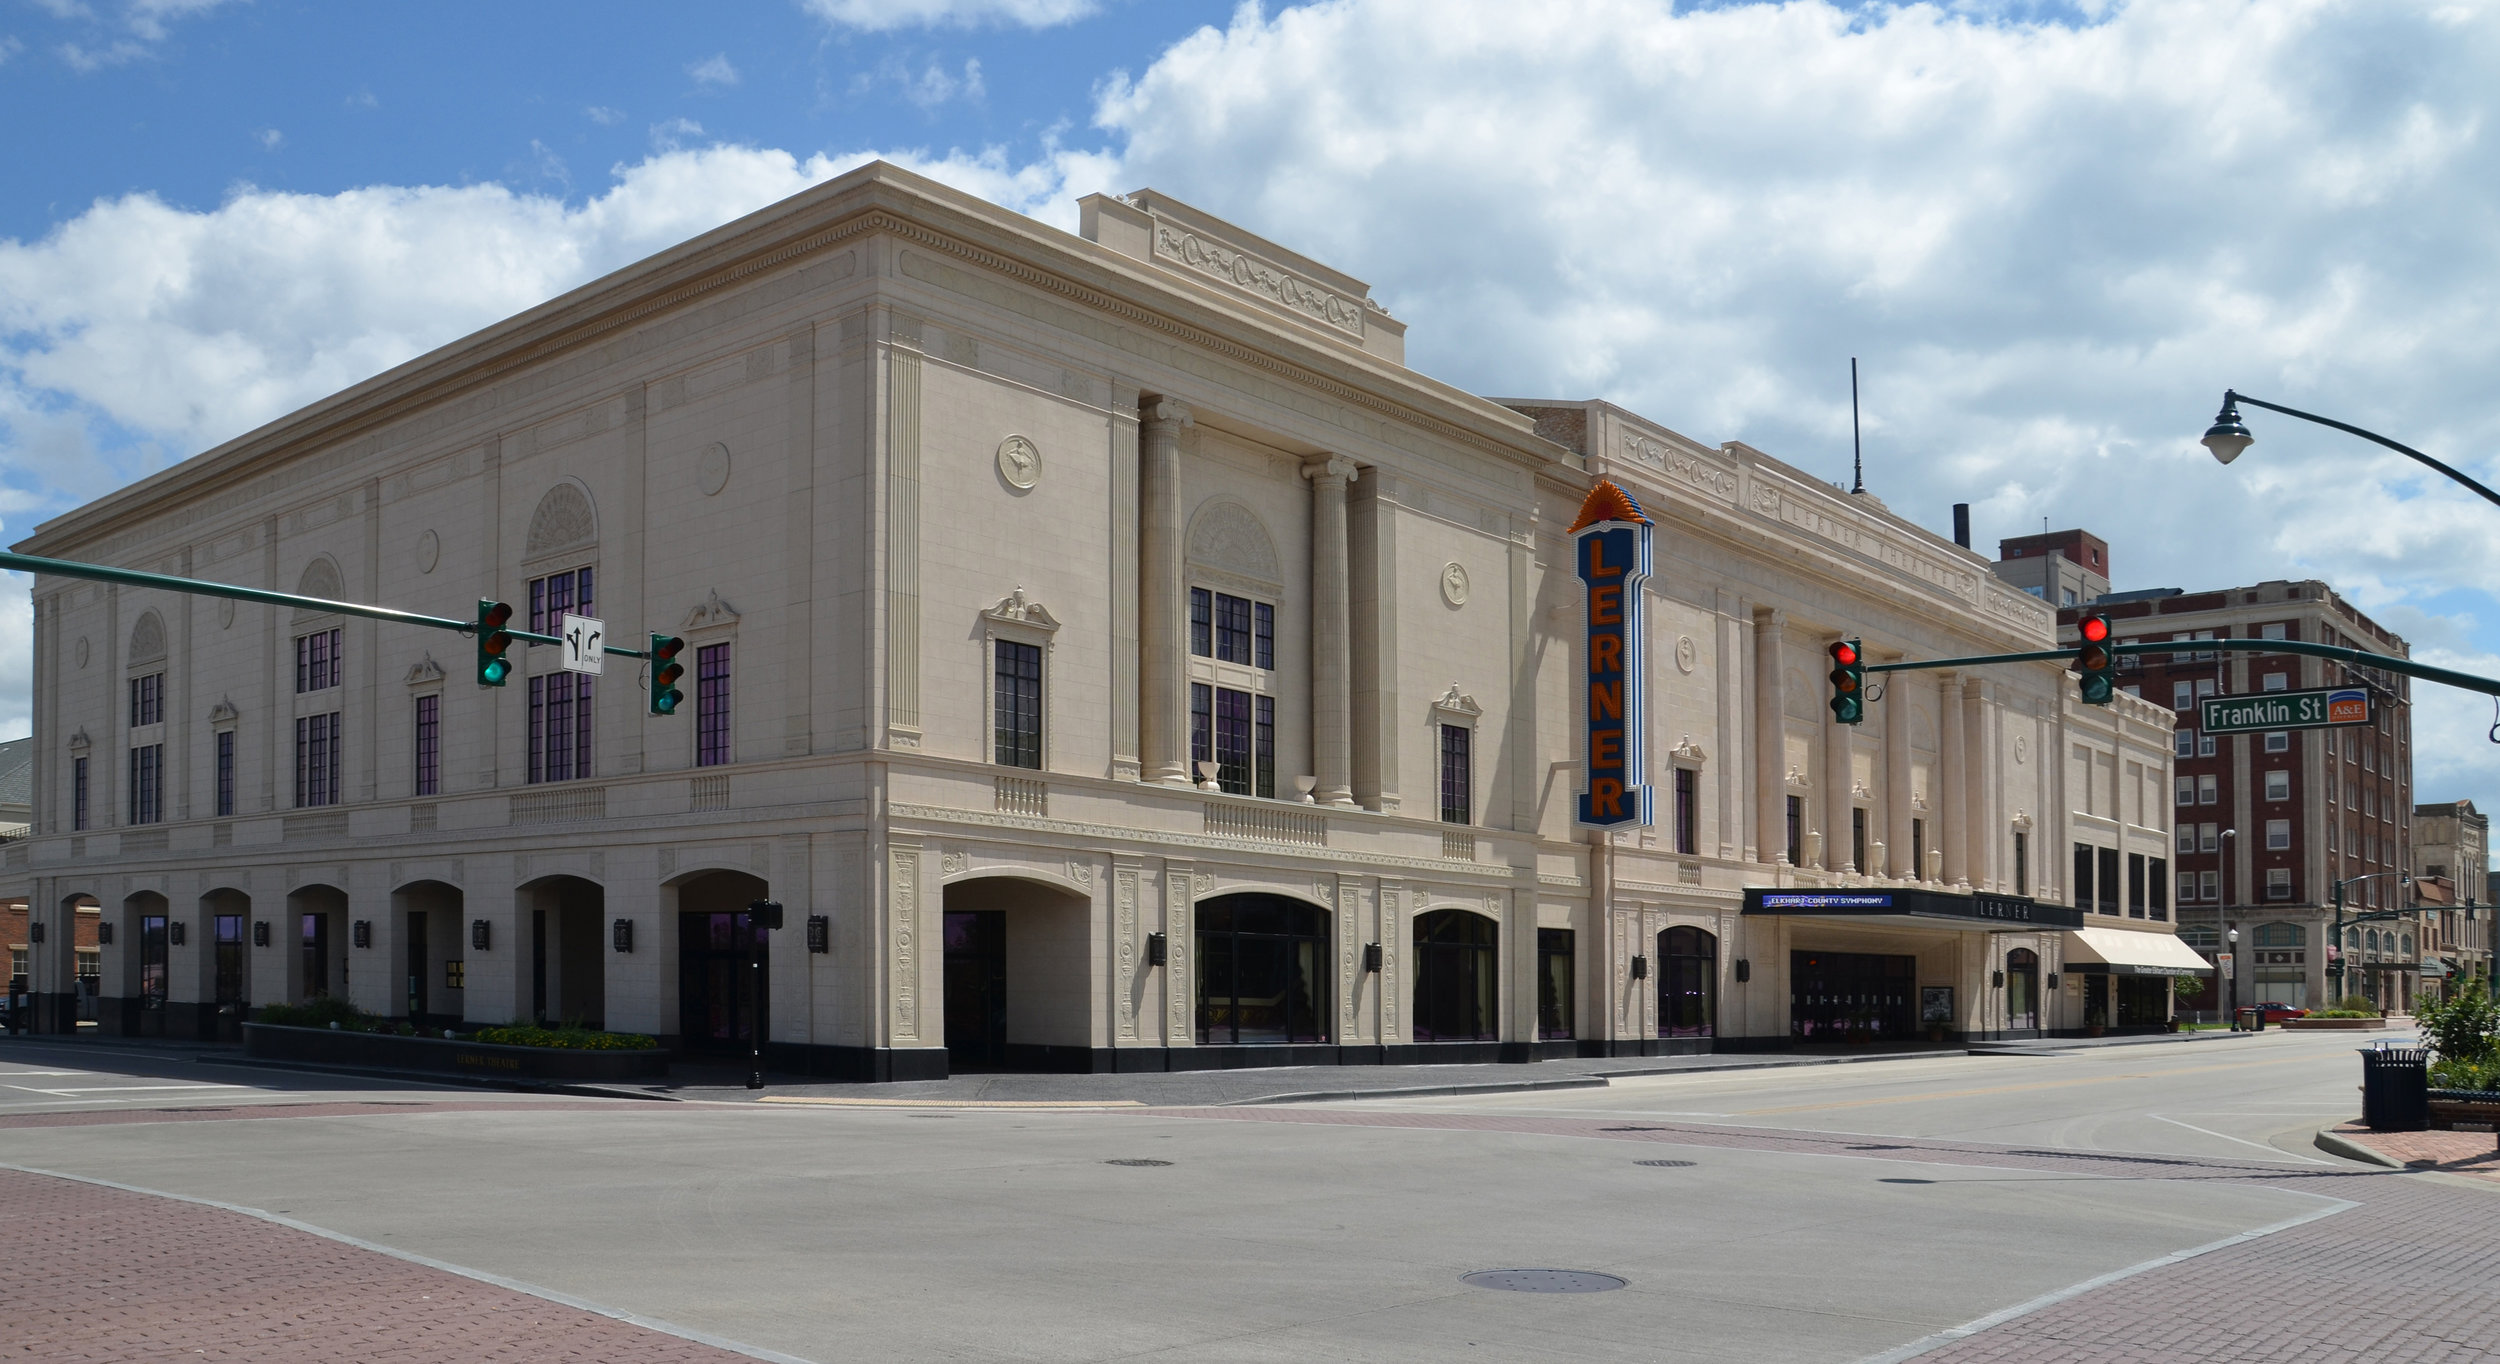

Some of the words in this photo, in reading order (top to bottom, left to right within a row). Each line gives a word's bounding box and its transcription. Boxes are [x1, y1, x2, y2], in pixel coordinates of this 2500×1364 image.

[584, 655, 601, 664] ONLY
[1590, 538, 1623, 817] LERNER
[2210, 701, 2289, 726] Franklin
[2299, 697, 2322, 721] St
[2334, 704, 2363, 715] A&E
[1980, 900, 2030, 920] LERNER
[457, 1054, 484, 1066] LERNER
